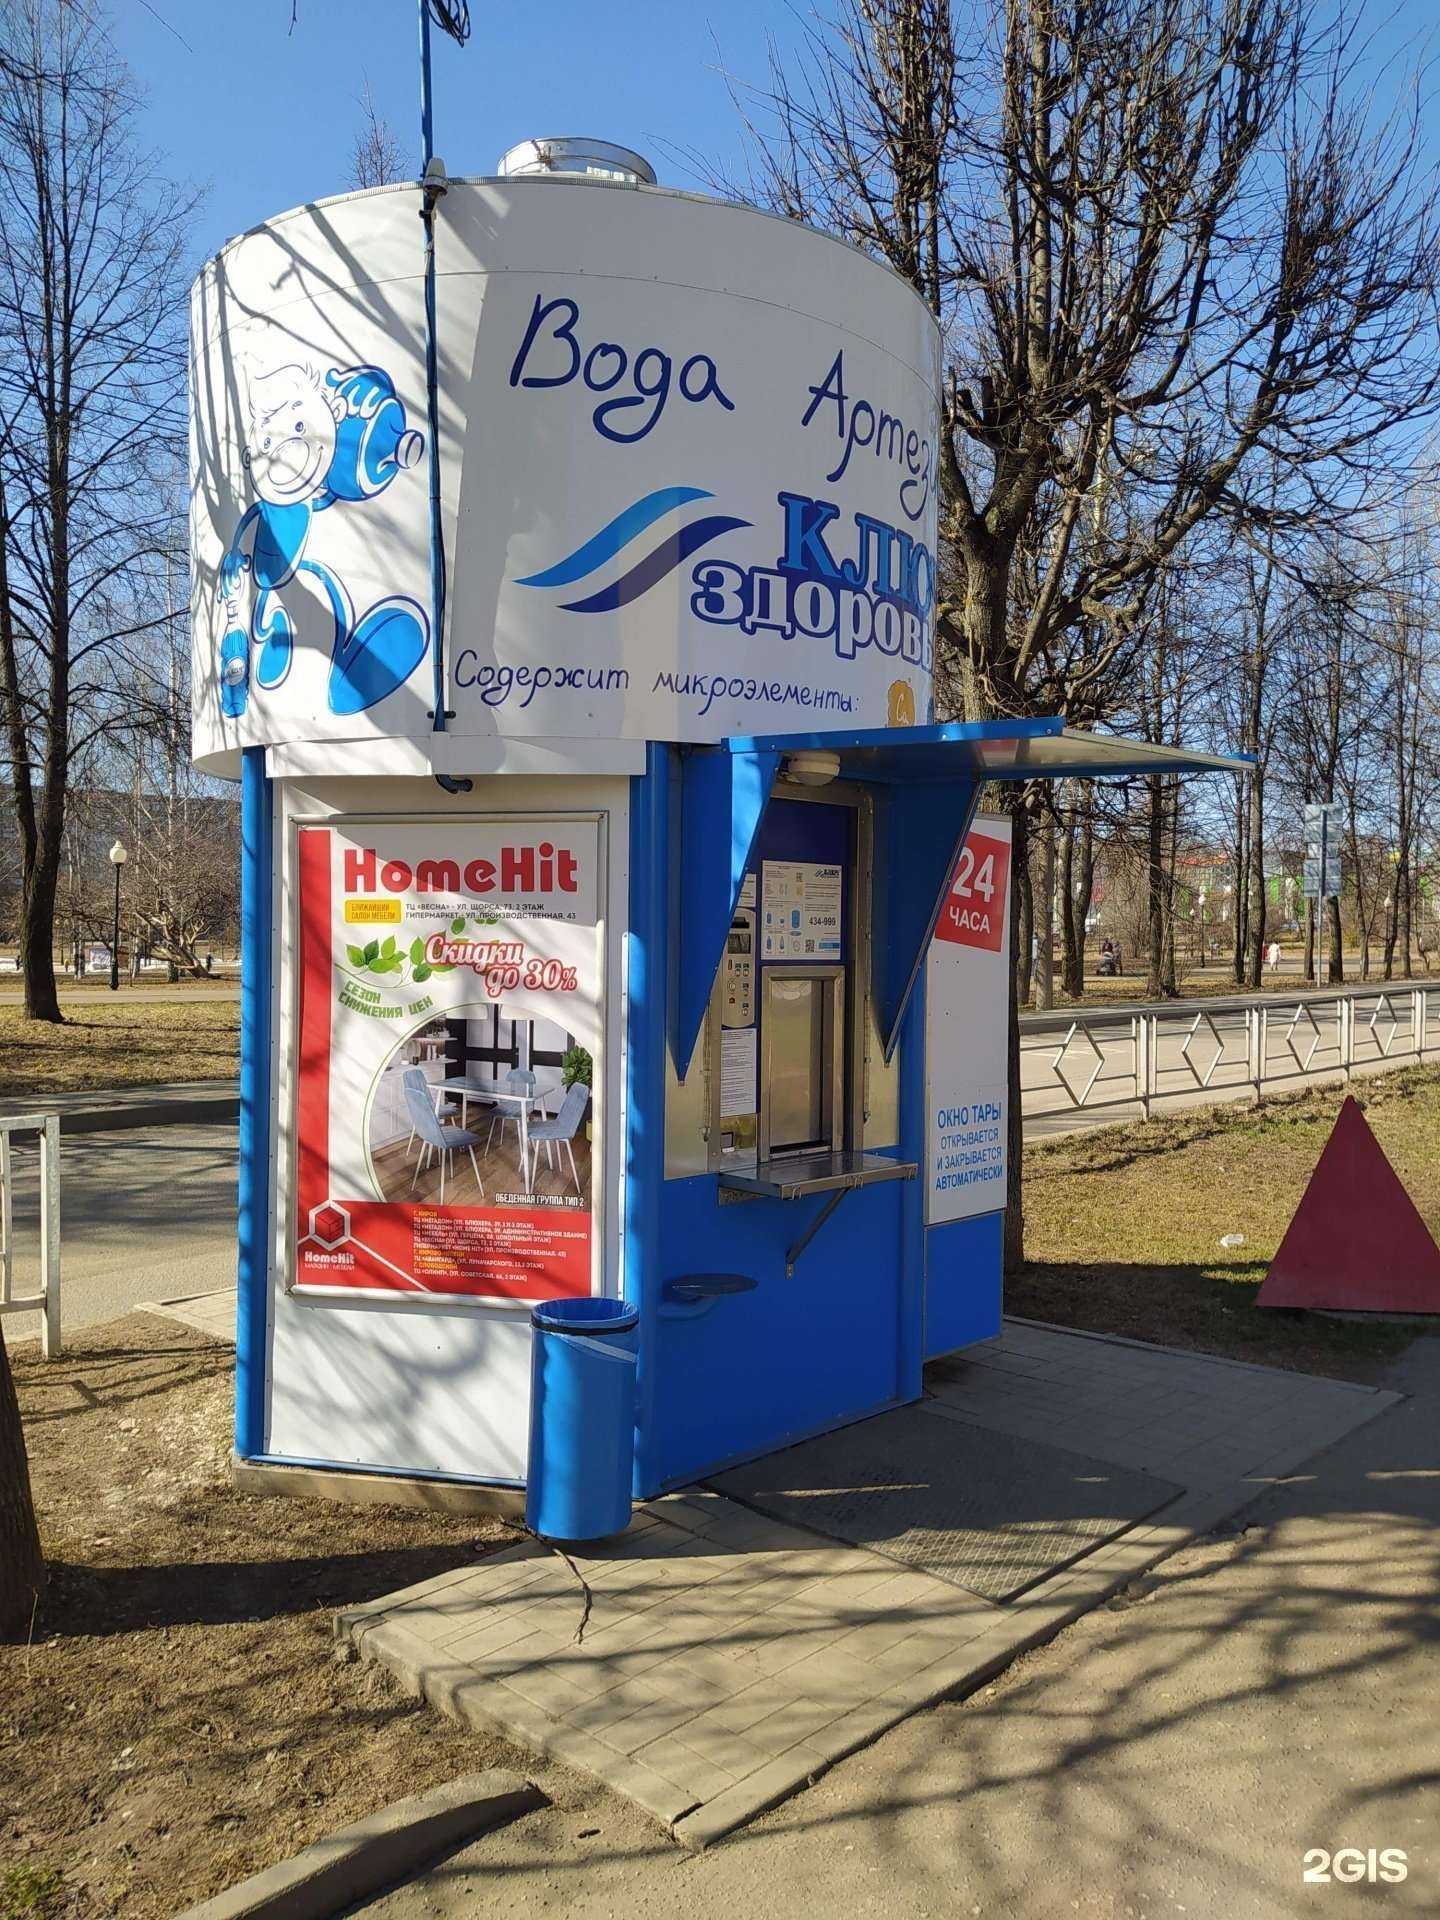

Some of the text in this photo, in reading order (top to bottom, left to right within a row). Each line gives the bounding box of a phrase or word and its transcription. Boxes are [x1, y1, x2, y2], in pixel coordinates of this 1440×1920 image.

[510, 294, 735, 443] Вода
[455, 649, 860, 715] Содержит микроэлементы:
[344, 842, 577, 892] HomeHit
[952, 846, 995, 903] 24
[949, 905, 990, 934] ЧАСА
[424, 933, 524, 973] Скидки
[484, 958, 578, 998] до 30%
[338, 992, 434, 1018] СНИЖЕНИЯ ЦЕН
[344, 980, 381, 1004] СЕЗОН
[938, 1102, 1002, 1129] ОКНО ТАРЫ
[940, 1128, 999, 1150] ОТКРЫВАЕТСЯ
[936, 1146, 1002, 1171] И ЗАКРЫВАЕТСЯ
[936, 1165, 1003, 1191] АВТОМАТИЧЕСКИ
[495, 1193, 584, 1207] ОБЕДЕННАЯ ГРУППА ТИП 2
[304, 1251, 355, 1264] HomeHit
